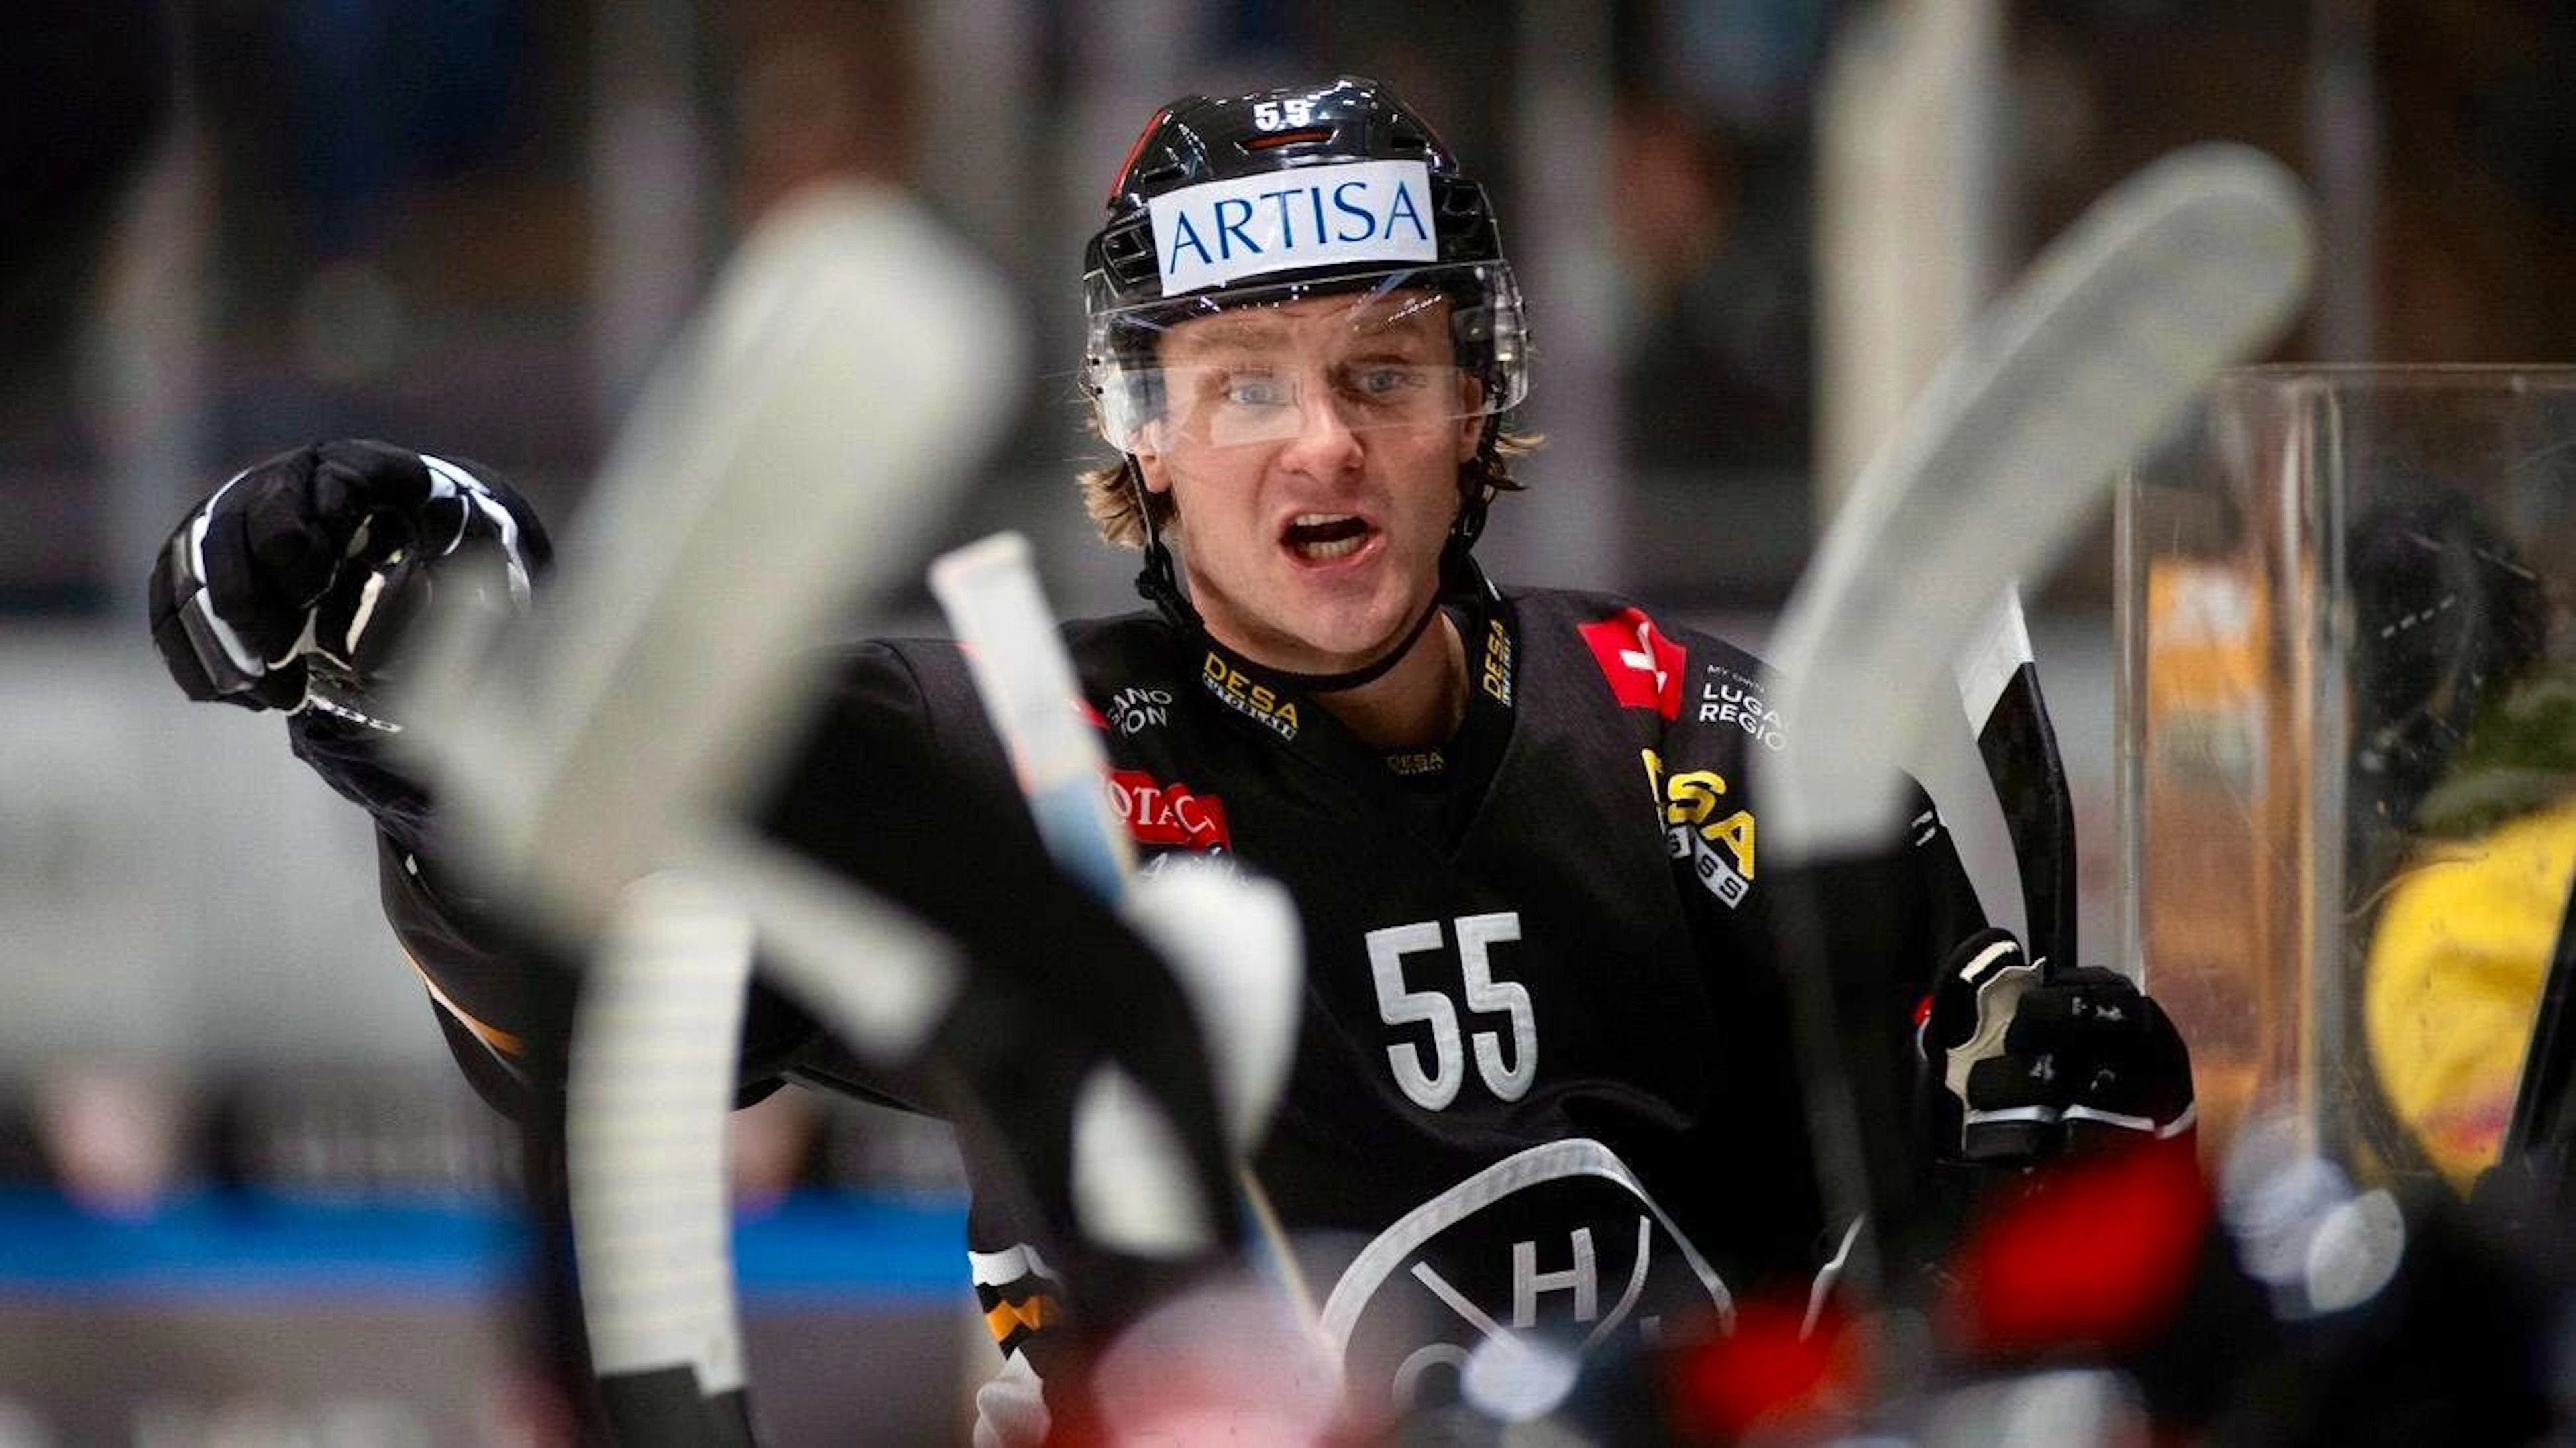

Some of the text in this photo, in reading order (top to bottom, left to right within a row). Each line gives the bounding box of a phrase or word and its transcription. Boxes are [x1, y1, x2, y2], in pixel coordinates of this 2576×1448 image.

[1253, 99, 1311, 132] 55
[1169, 182, 1428, 274] ARTISA
[1204, 651, 1299, 730] DESA
[1703, 682, 1783, 729] LUGA
[1699, 704, 1787, 751] REGIO
[1364, 911, 1538, 1112] 55
